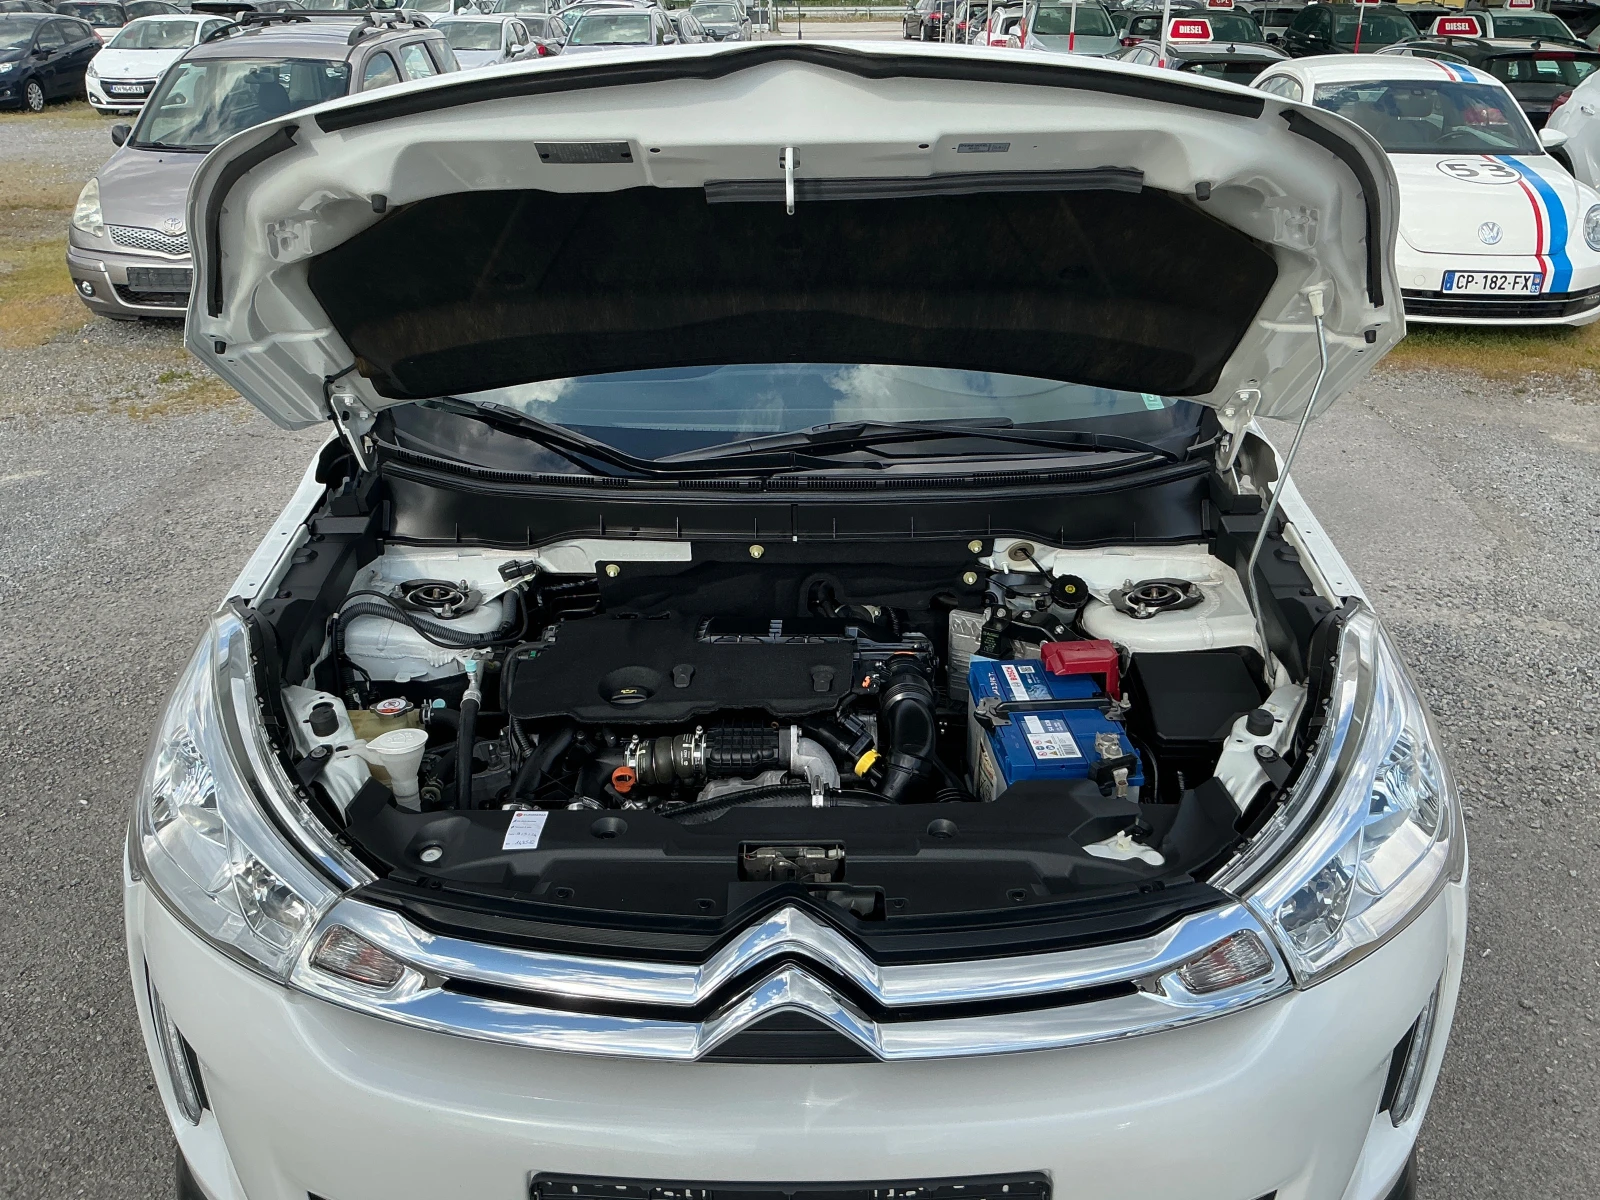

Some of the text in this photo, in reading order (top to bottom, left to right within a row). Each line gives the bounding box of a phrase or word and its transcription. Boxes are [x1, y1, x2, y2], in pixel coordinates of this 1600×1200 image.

[1179, 25, 1202, 34] DIESEL
[1445, 22, 1470, 31] DIESEL
[1445, 163, 1515, 178] 53
